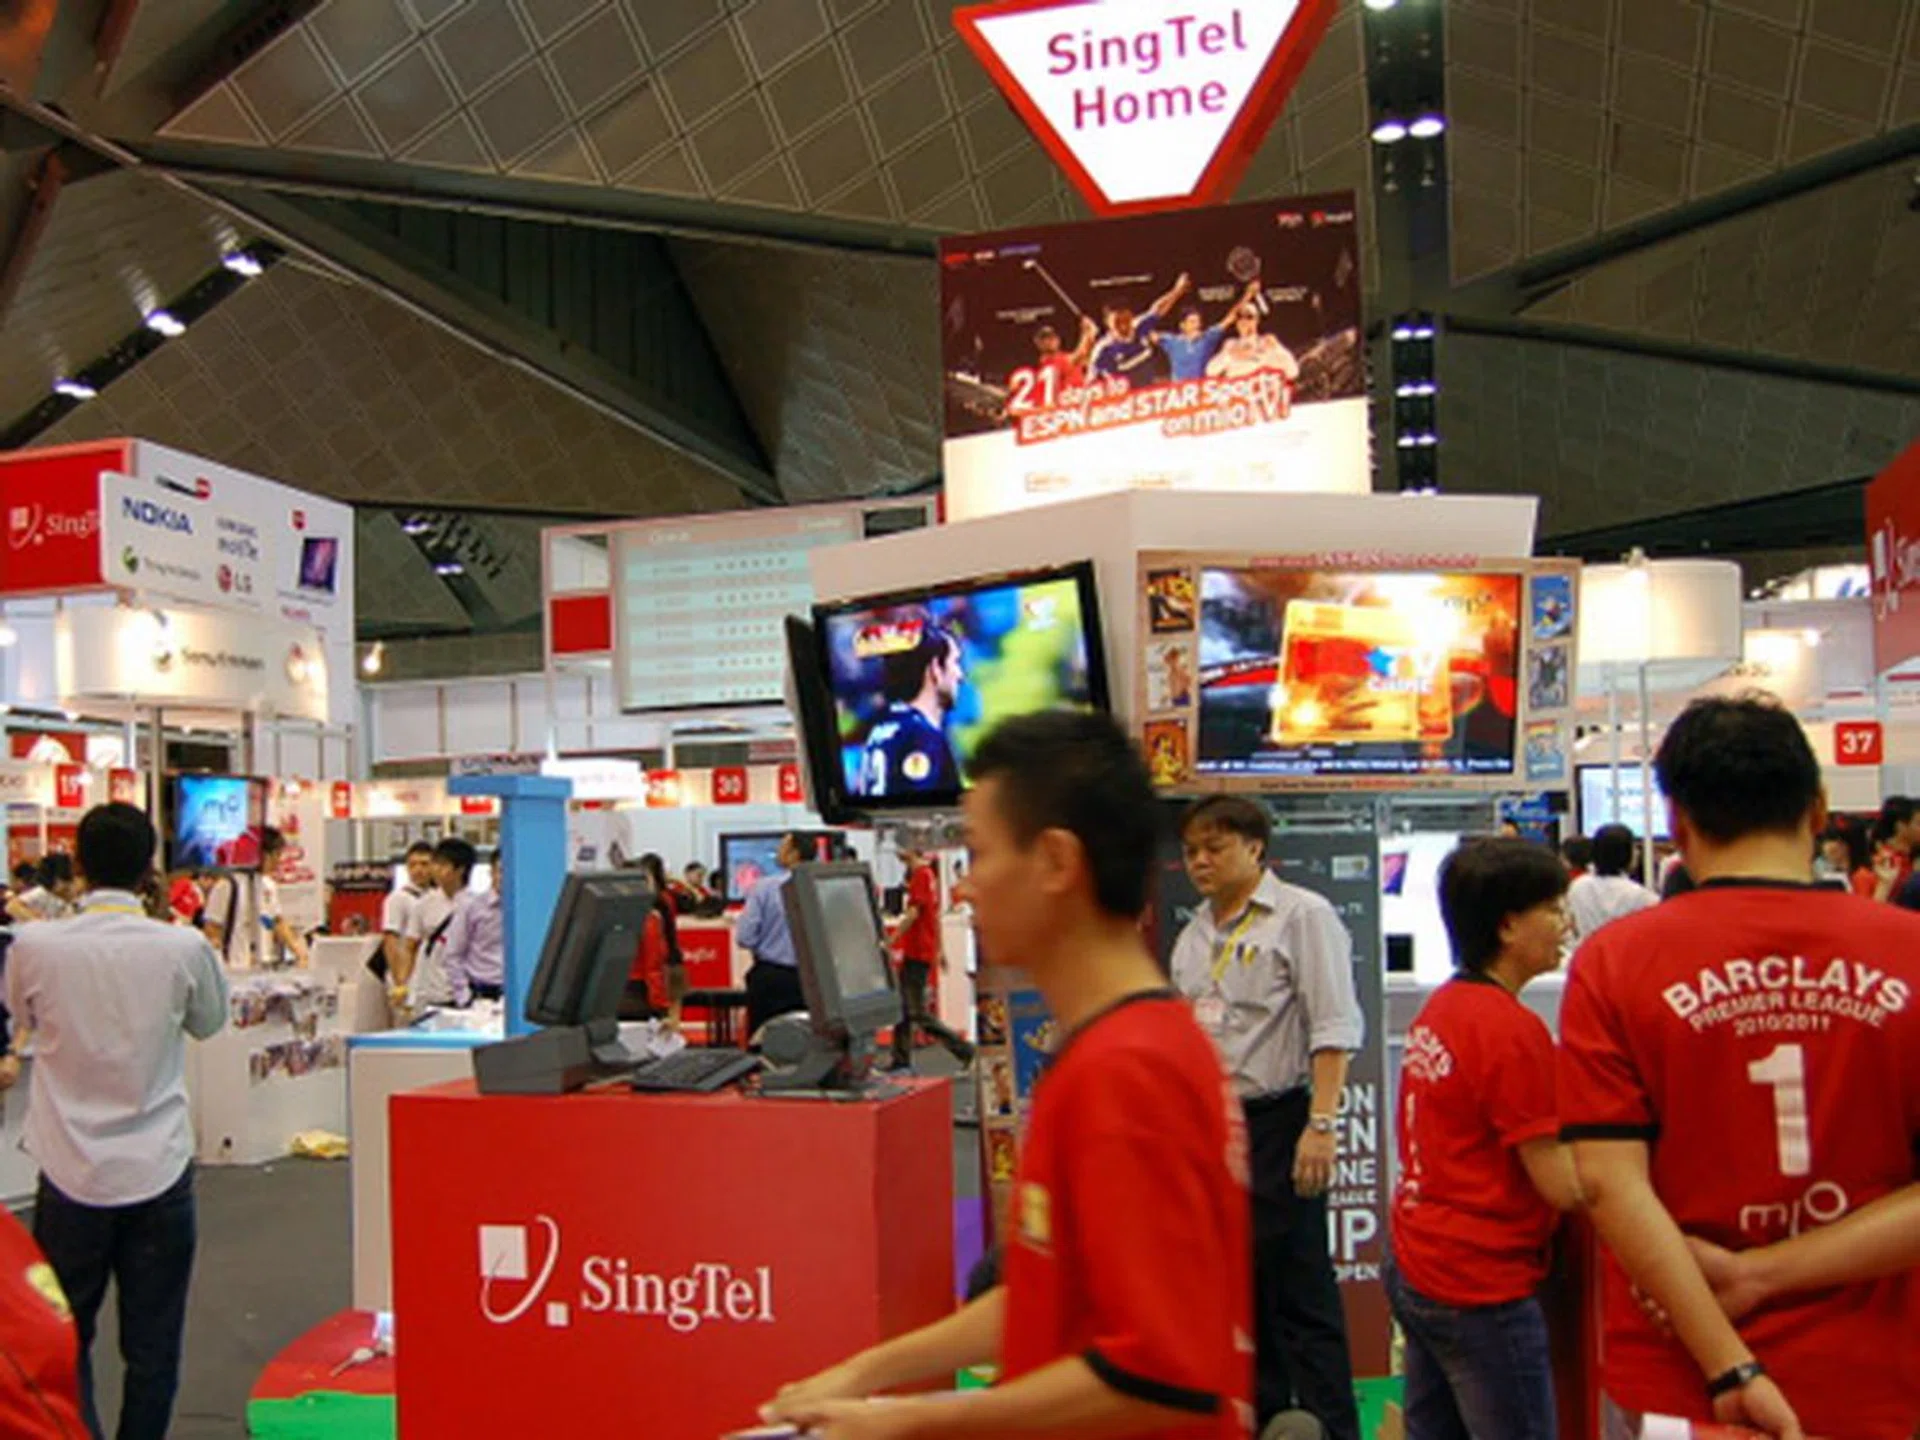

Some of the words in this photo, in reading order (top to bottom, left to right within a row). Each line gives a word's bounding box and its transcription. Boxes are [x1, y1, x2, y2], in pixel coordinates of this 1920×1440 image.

[1046, 9, 1247, 75] SingTel
[1073, 79, 1228, 130] Home
[1011, 366, 1056, 410] 21
[1021, 406, 1085, 439] ESPN
[1135, 383, 1198, 417] STAR
[123, 496, 193, 535] NOKIA
[1841, 731, 1875, 754] 37
[1662, 956, 1910, 1019] BARCLAYS
[1689, 992, 1785, 1033] PREMIER
[1790, 991, 1888, 1028] LEAGUE
[1747, 1043, 1811, 1177] 1
[579, 1254, 775, 1331] SingTel
